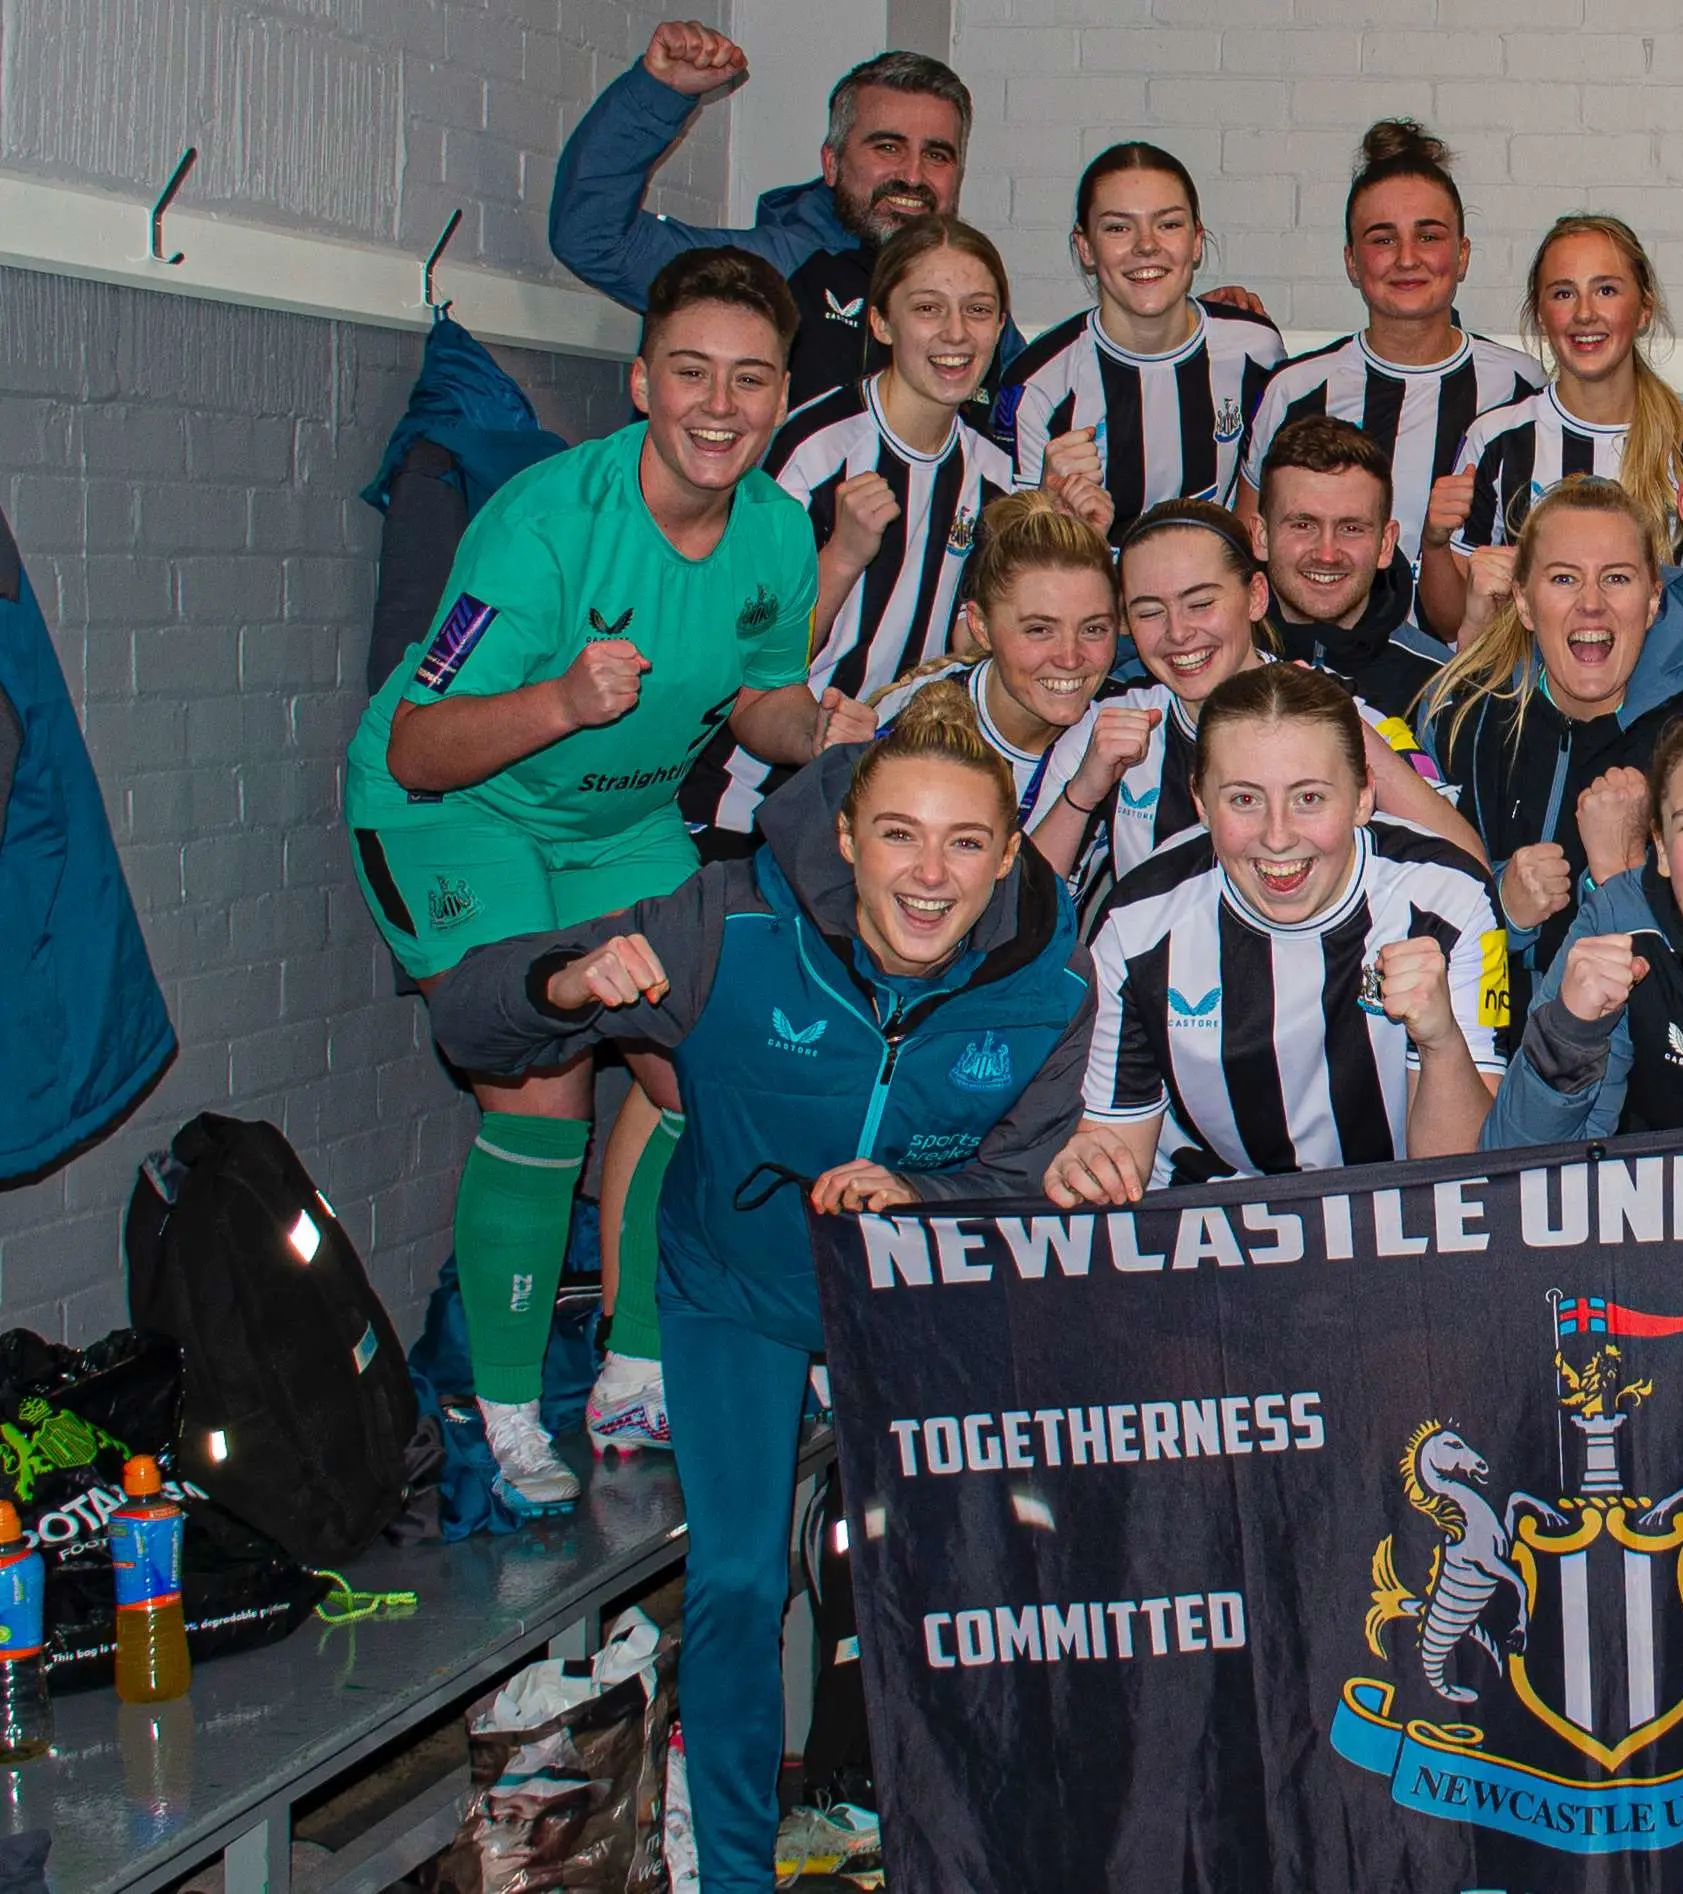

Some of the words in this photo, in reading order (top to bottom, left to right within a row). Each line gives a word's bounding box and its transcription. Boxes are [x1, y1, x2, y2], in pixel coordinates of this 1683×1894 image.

[910, 1133, 982, 1150] sports
[890, 1391, 1325, 1477] TOGETHERNESS
[200, 1608, 258, 1630] degradable
[923, 1591, 1246, 1669] COMMITTED
[52, 1651, 74, 1664] This
[77, 1647, 98, 1660] bag
[1410, 1764, 1656, 1836] NEWCASTLE
